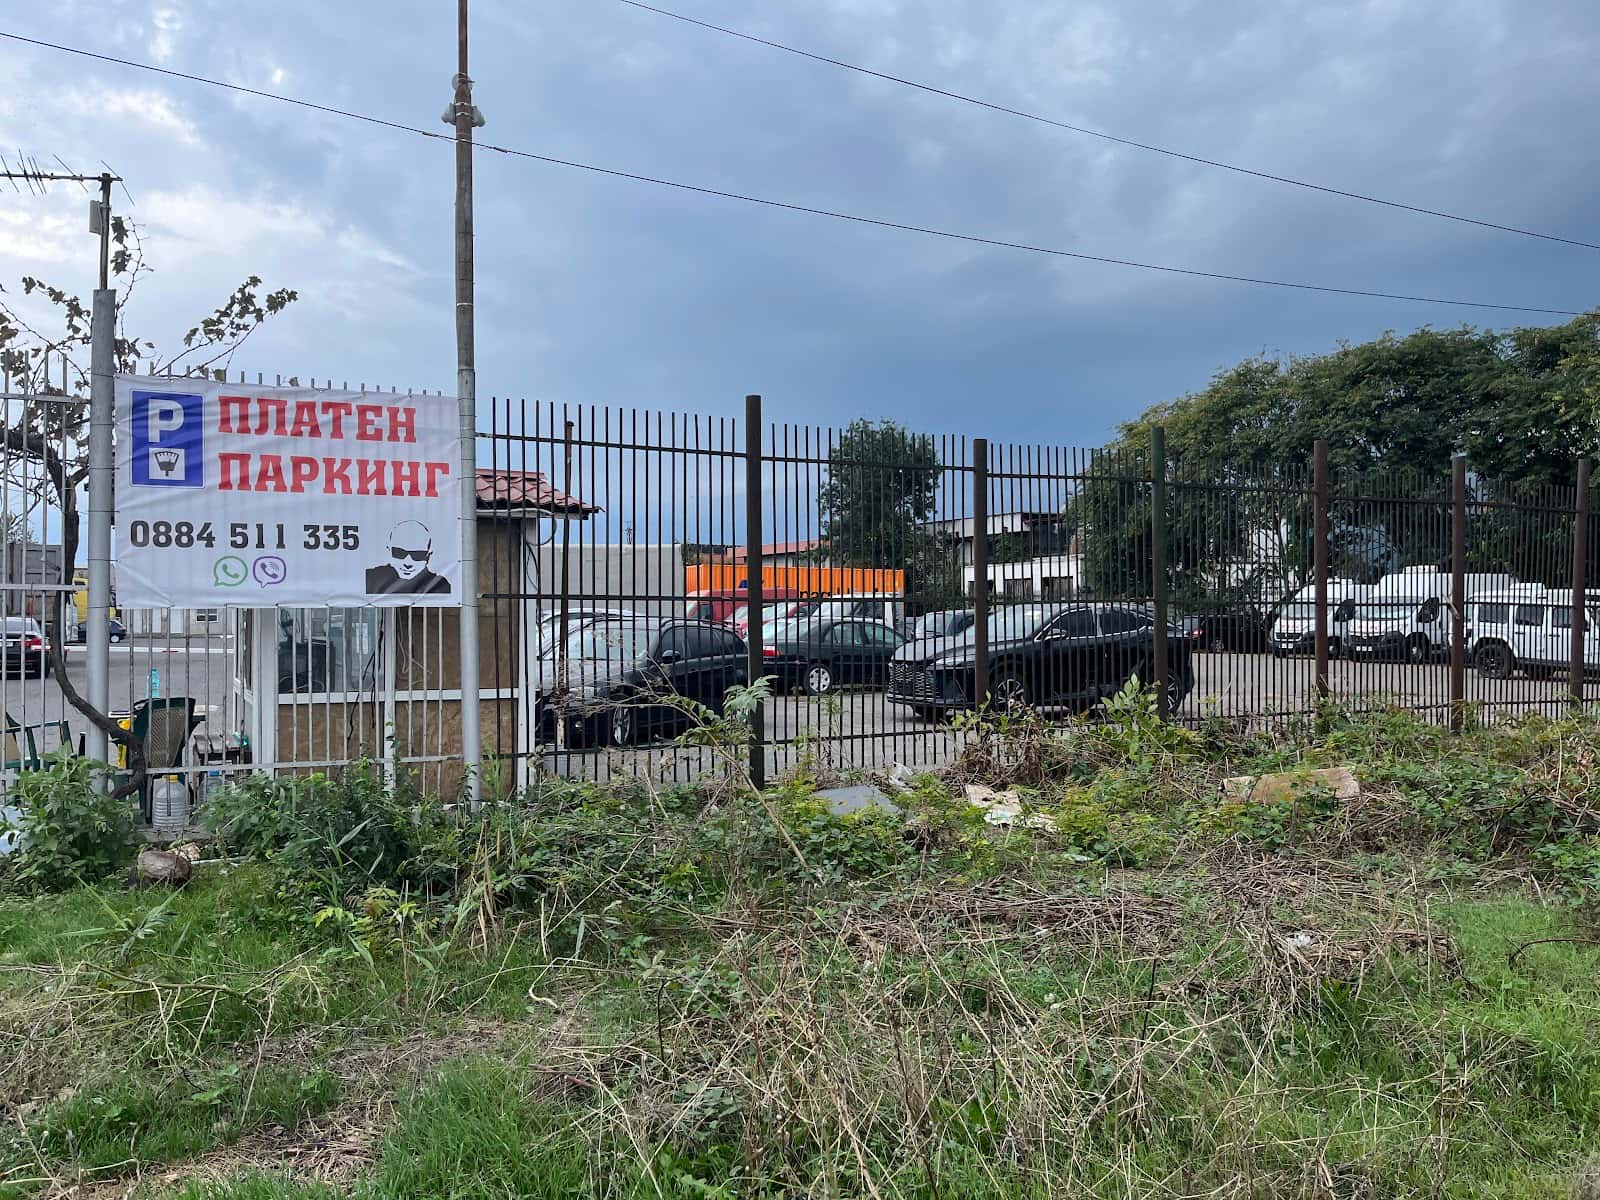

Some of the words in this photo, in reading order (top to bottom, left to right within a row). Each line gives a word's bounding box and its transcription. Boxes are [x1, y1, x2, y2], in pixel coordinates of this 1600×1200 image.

[148, 399, 184, 443] P
[218, 396, 416, 443] ПЛАТЕН
[218, 452, 450, 497] ПАРКИНГ
[130, 520, 216, 548] 0884
[230, 522, 286, 549] 511
[303, 524, 360, 550] 335
